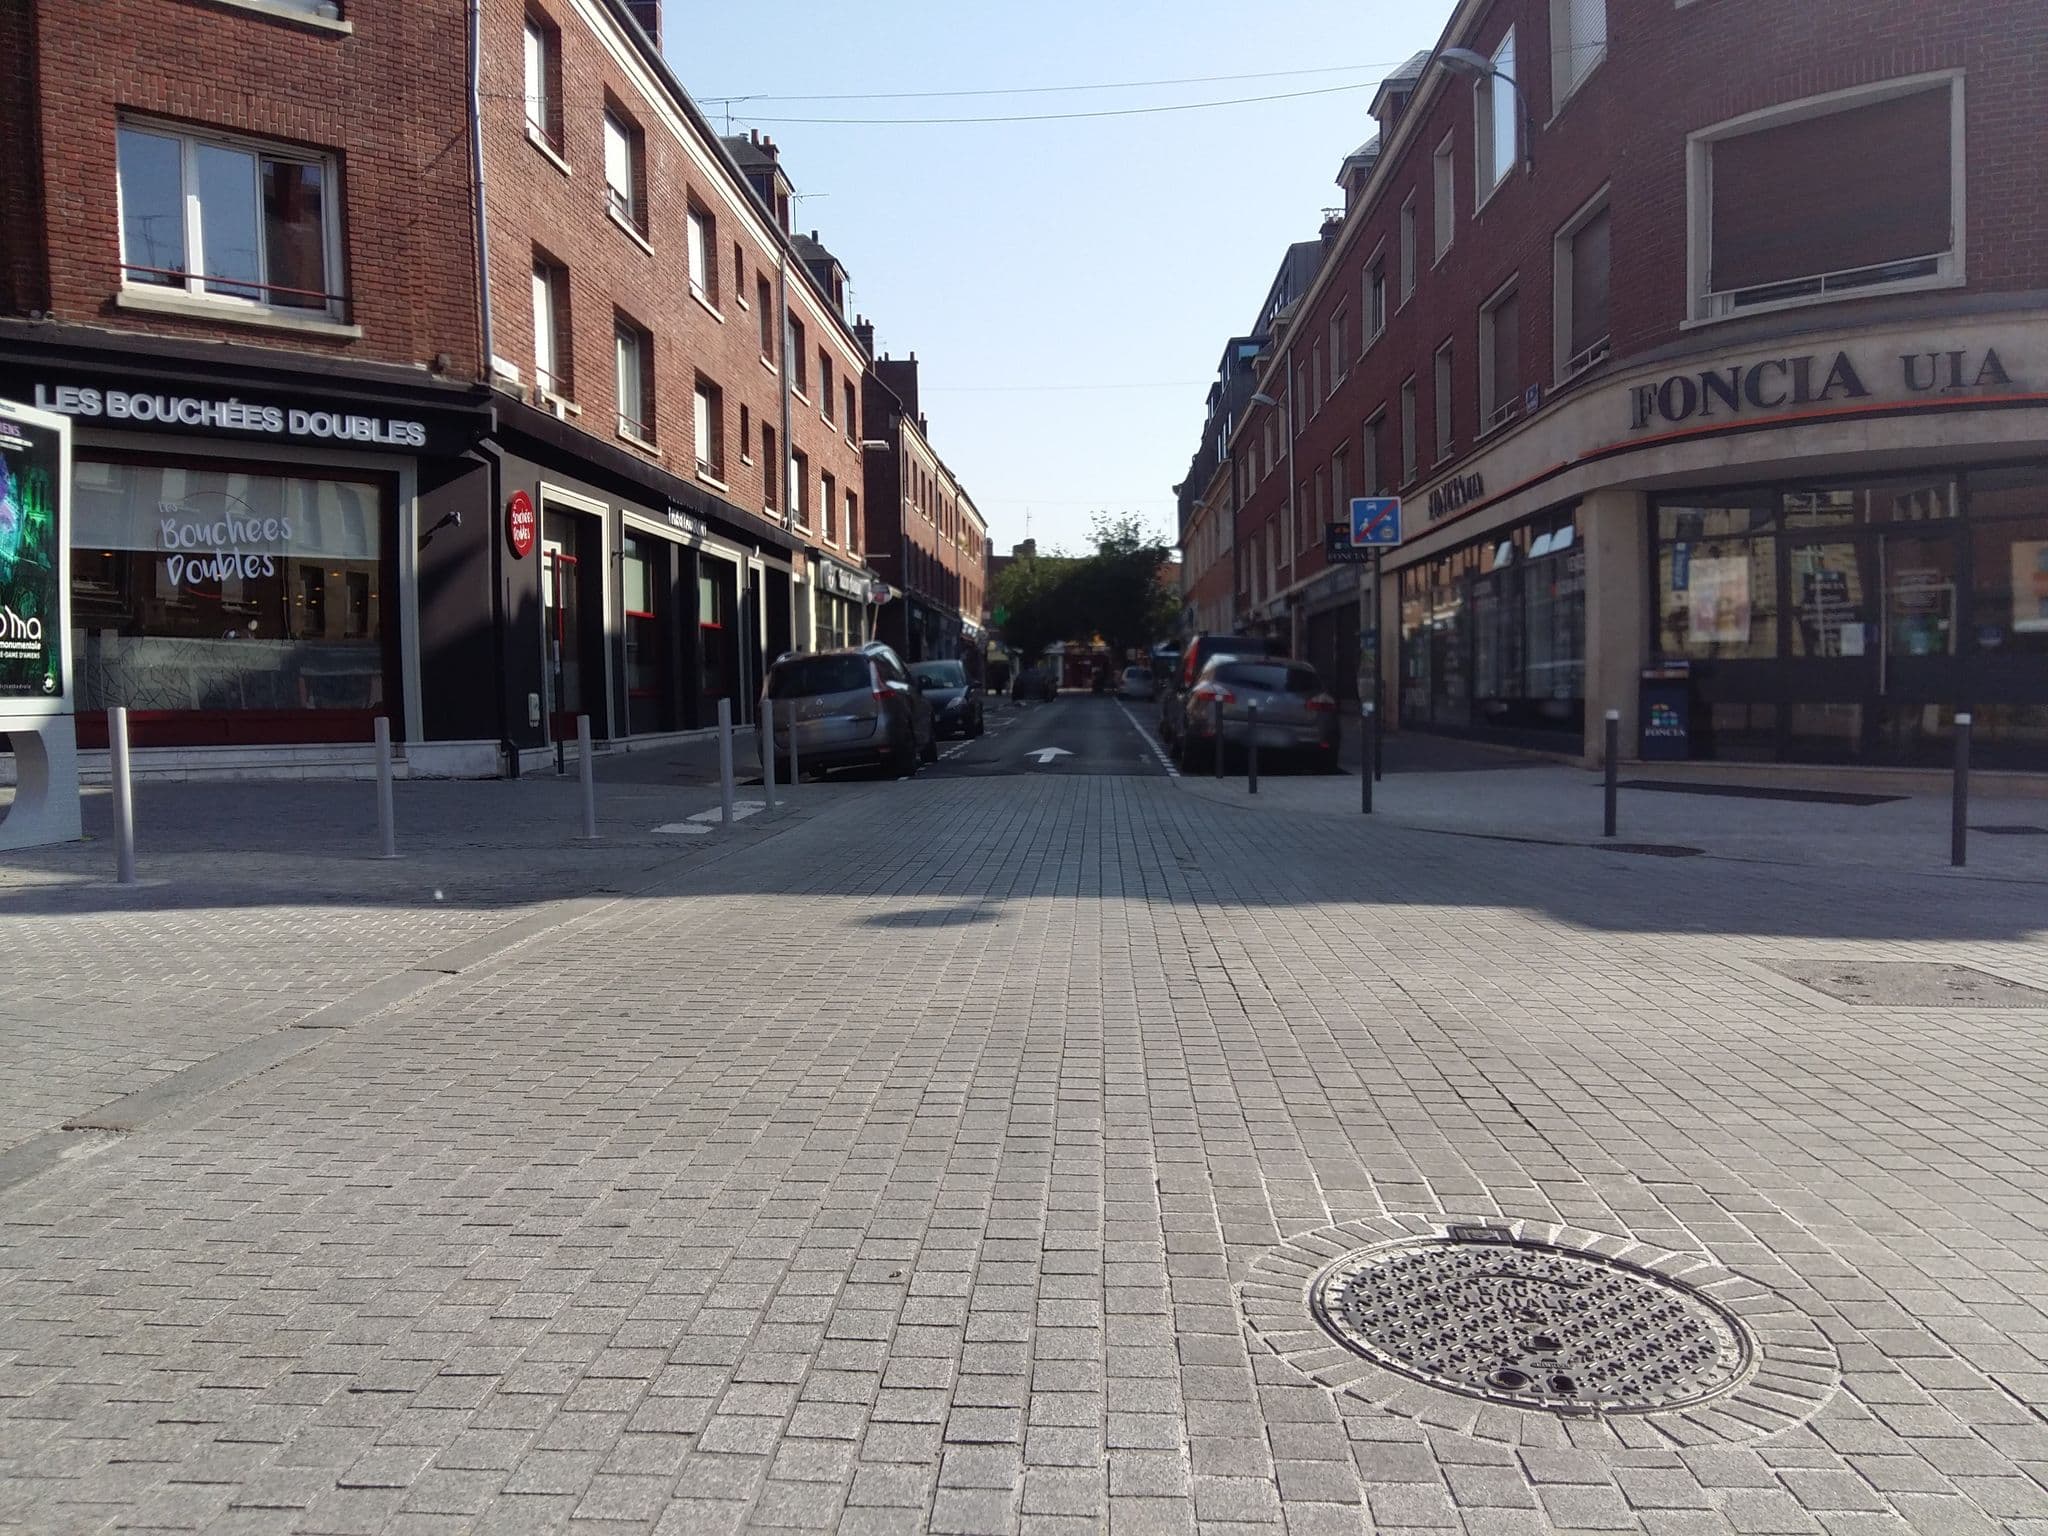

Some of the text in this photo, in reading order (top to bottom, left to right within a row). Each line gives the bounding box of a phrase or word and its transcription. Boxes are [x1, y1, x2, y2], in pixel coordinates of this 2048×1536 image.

[1628, 347, 2013, 431] FONCIA UIA
[35, 383, 427, 446] LES BOUCHÉES DOUBLES
[166, 547, 275, 586] Doubles
[1644, 727, 1687, 737] FONCIA
[1477, 1284, 1549, 1298] EAUX
